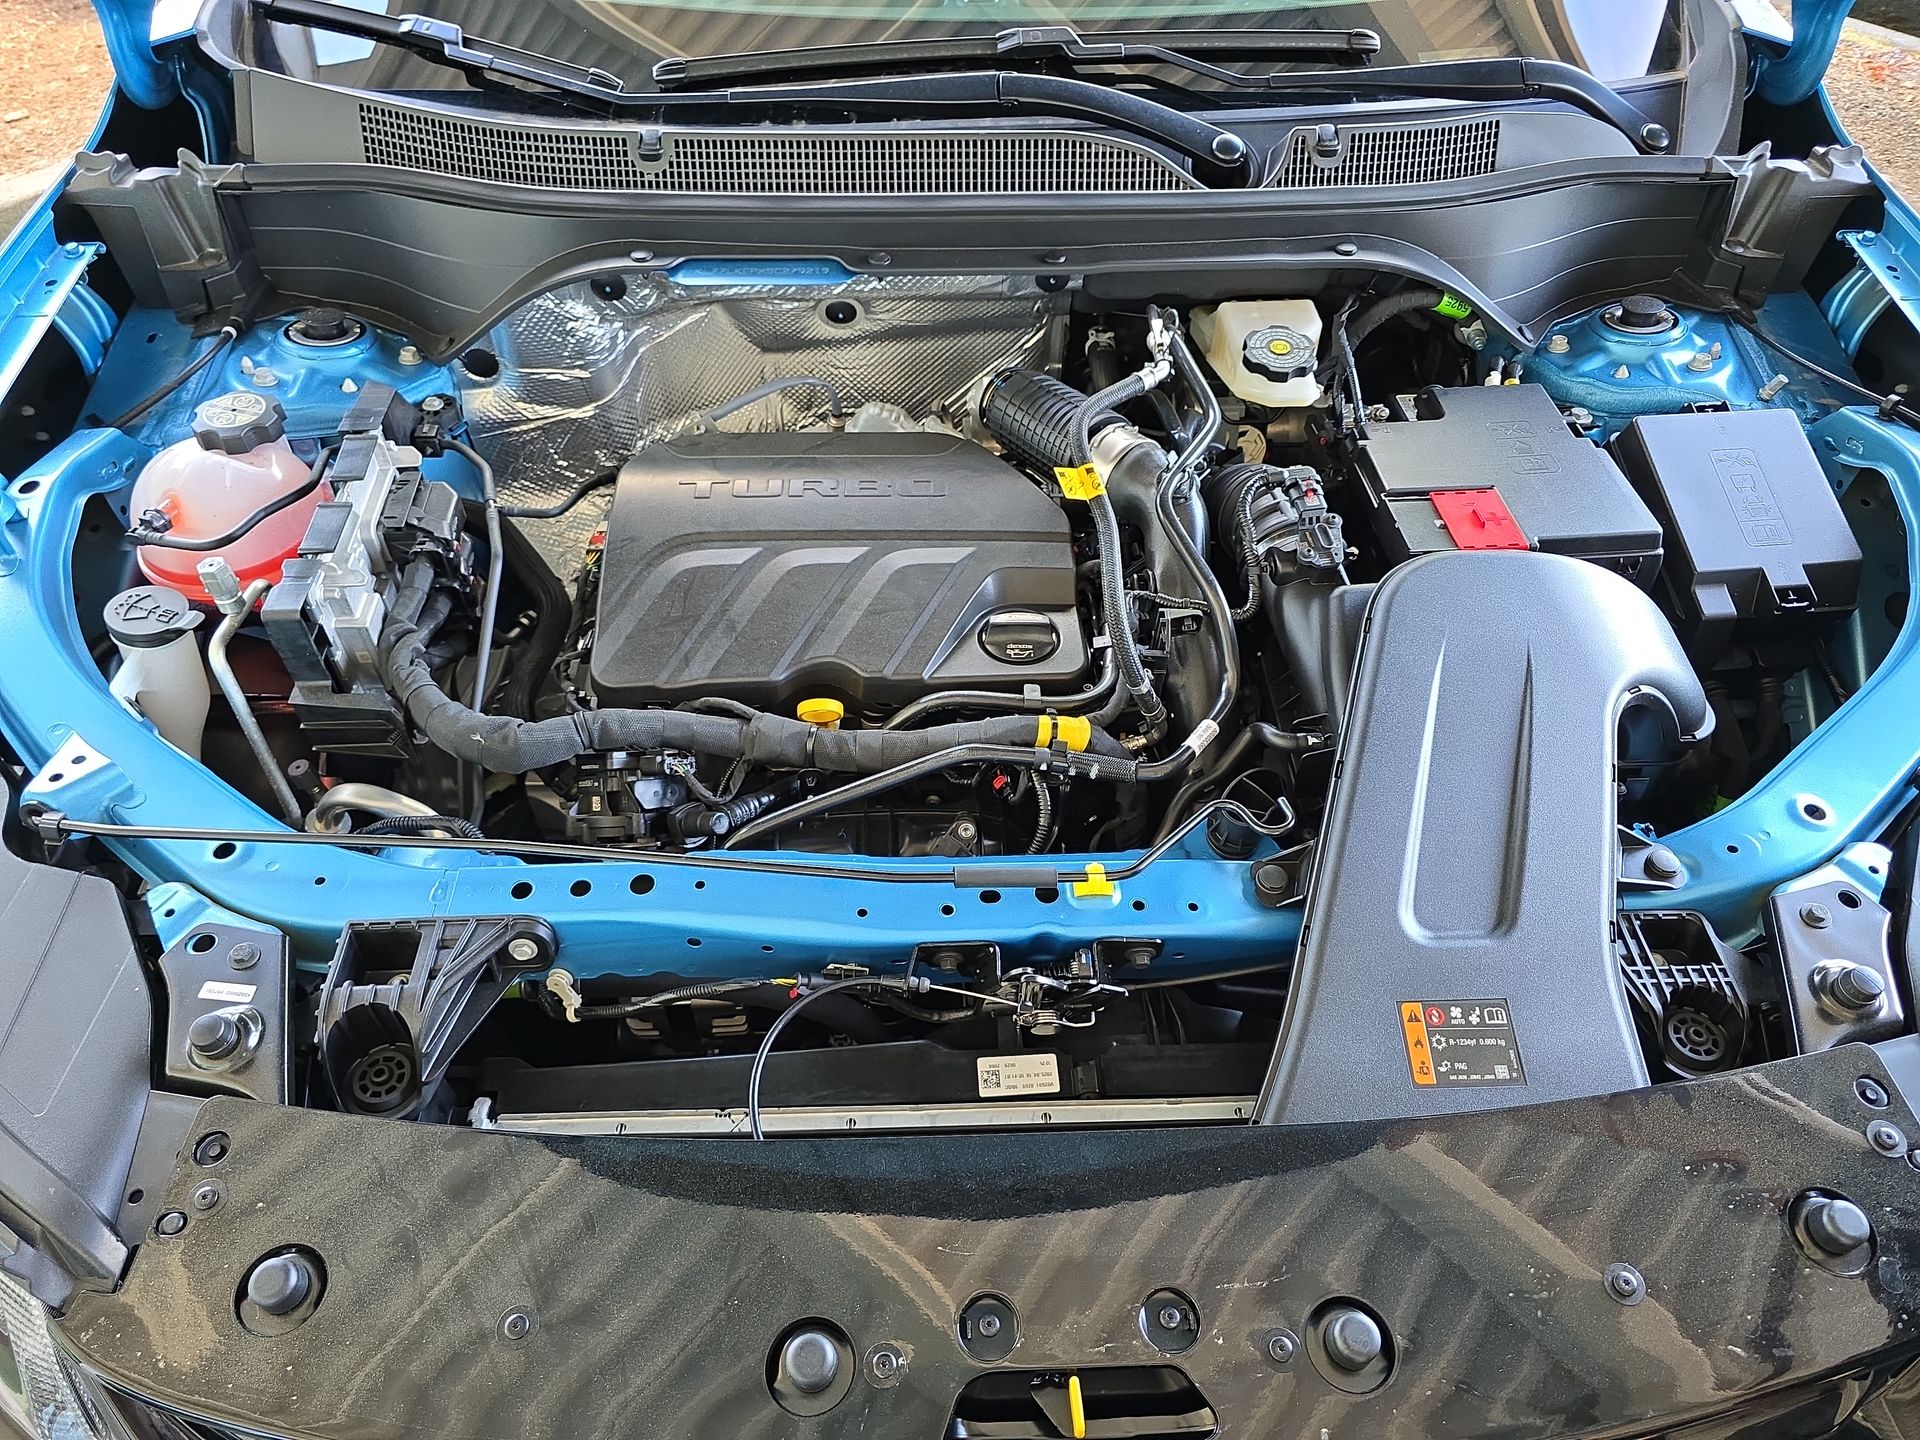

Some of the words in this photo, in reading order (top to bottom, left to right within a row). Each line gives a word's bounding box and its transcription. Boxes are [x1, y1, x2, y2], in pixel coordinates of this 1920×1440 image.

[1445, 296, 1469, 313] 5925
[679, 478, 949, 500] TURBO
[1497, 1038, 1506, 1047] kg
[1454, 1062, 1468, 1070] PAG
